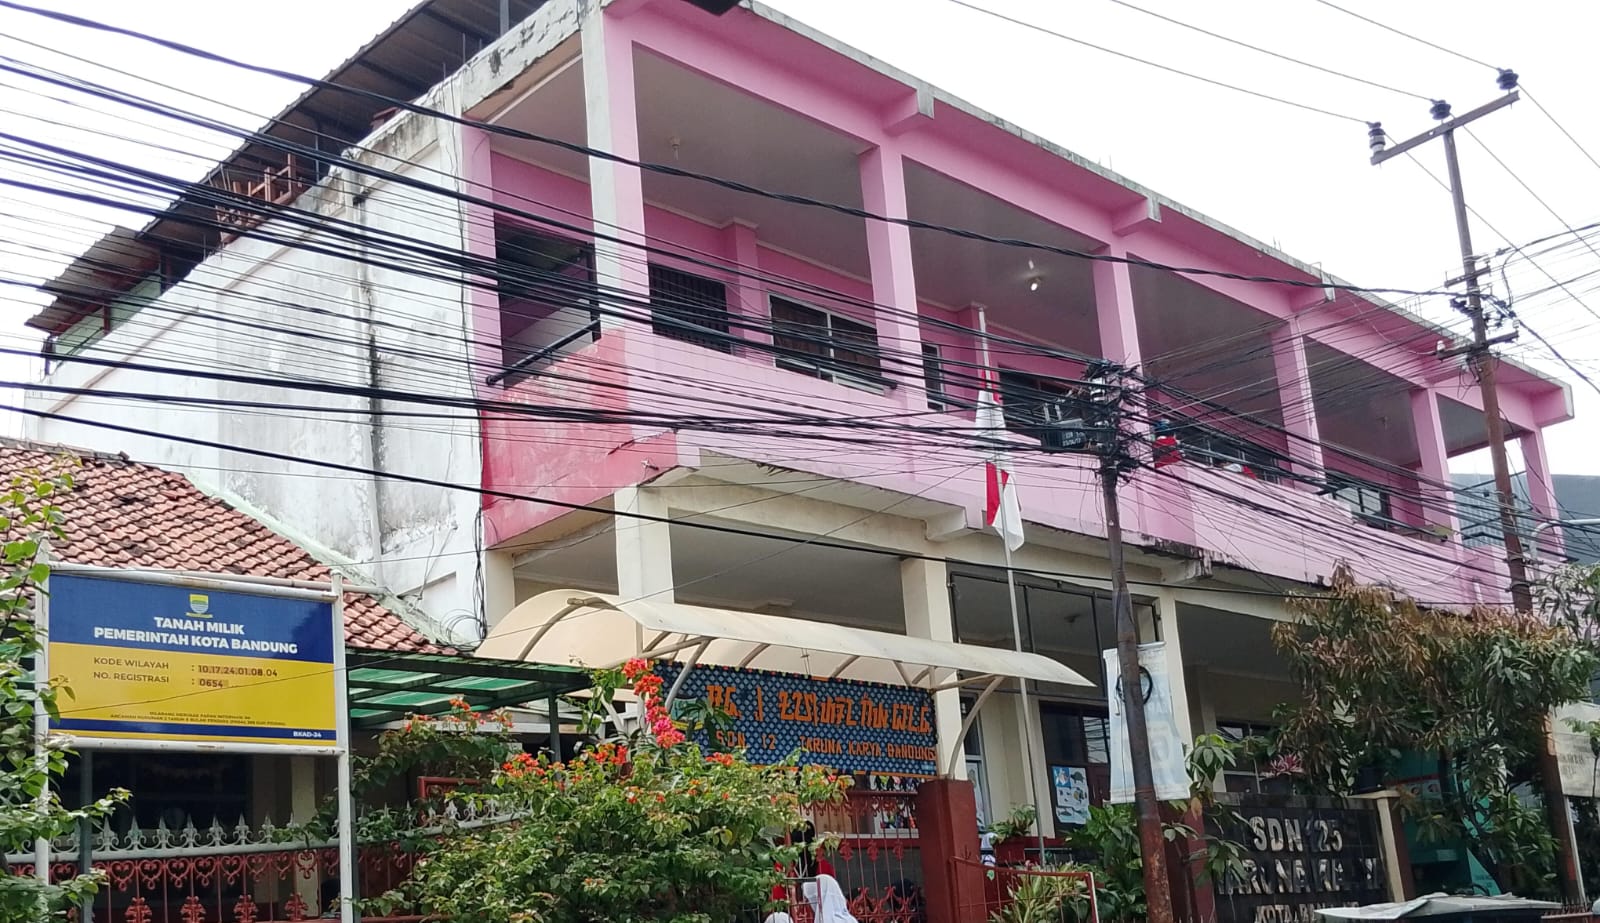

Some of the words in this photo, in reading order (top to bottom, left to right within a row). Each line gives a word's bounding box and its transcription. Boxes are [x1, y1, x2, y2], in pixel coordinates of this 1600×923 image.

[153, 616, 204, 632] TANAH
[206, 621, 245, 635] MILIK
[94, 627, 189, 645] PEMERINTAH
[191, 635, 229, 649] KOTA
[231, 639, 298, 654] BANDUNG
[93, 657, 122, 666] KODE
[125, 659, 169, 670] WILAYAH
[93, 671, 111, 680] NO.
[113, 672, 169, 683] REGISTRASI
[199, 678, 223, 688] 0654
[799, 735, 843, 755] TARUNA
[847, 740, 882, 758] KARYA
[886, 742, 937, 761] BANDUNG
[1250, 815, 1303, 852] SDN
